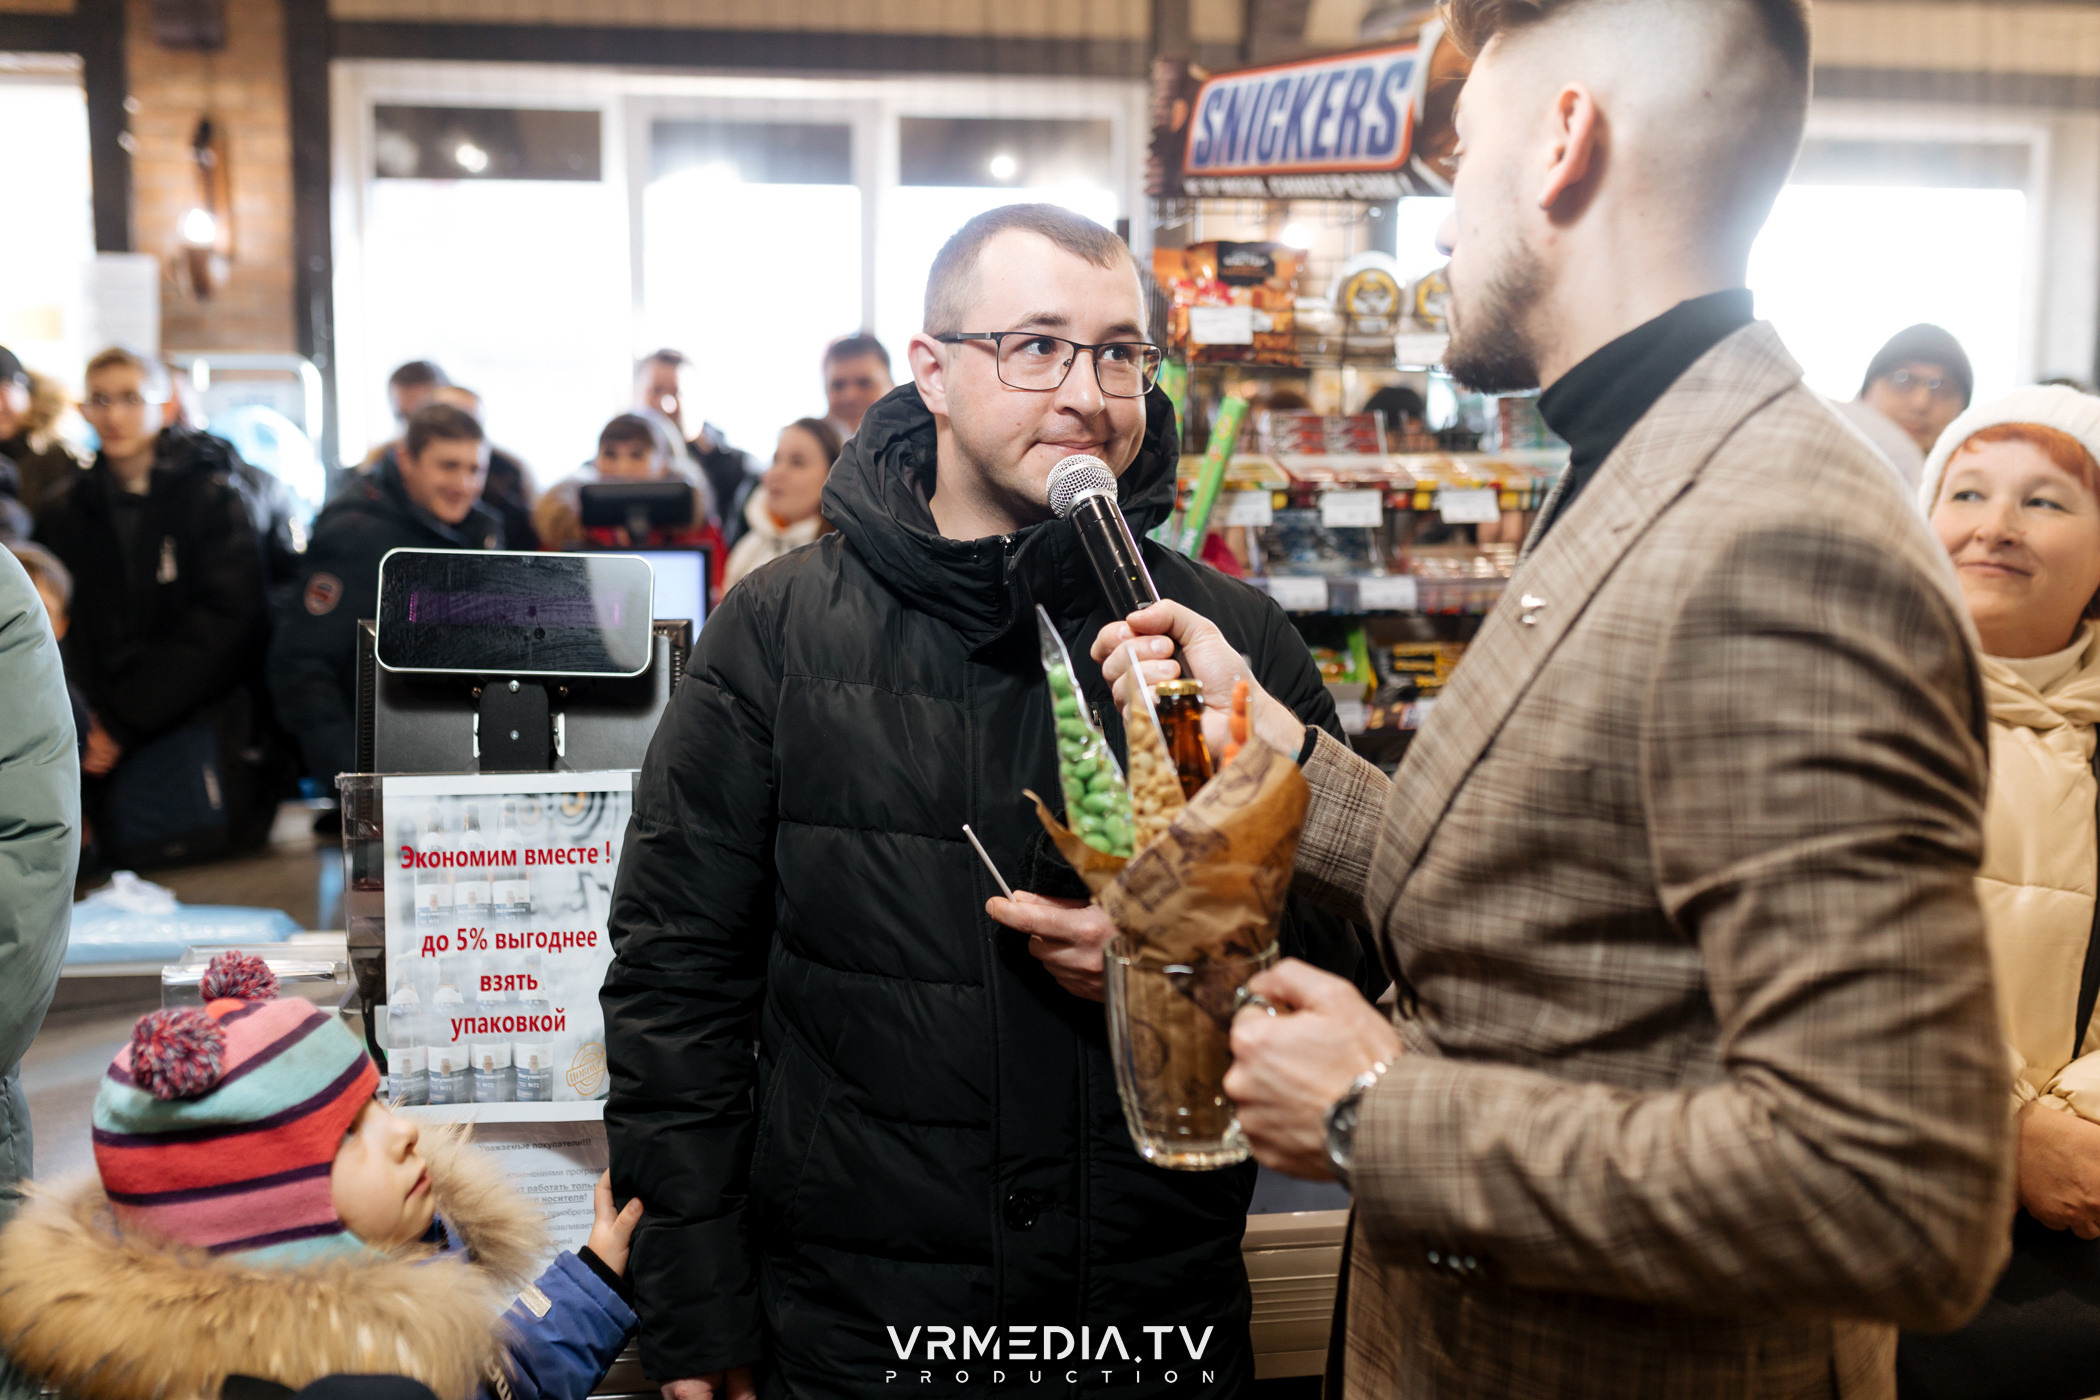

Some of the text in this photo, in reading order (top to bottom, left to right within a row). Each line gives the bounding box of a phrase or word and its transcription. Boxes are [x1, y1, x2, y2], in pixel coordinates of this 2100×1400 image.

[1194, 60, 1414, 166] SNICKERS
[401, 845, 517, 869] Экономим
[525, 847, 599, 865] вместе
[421, 927, 598, 957] до 5% выгоднее
[480, 974, 538, 992] взять
[451, 1008, 566, 1042] упаковкой
